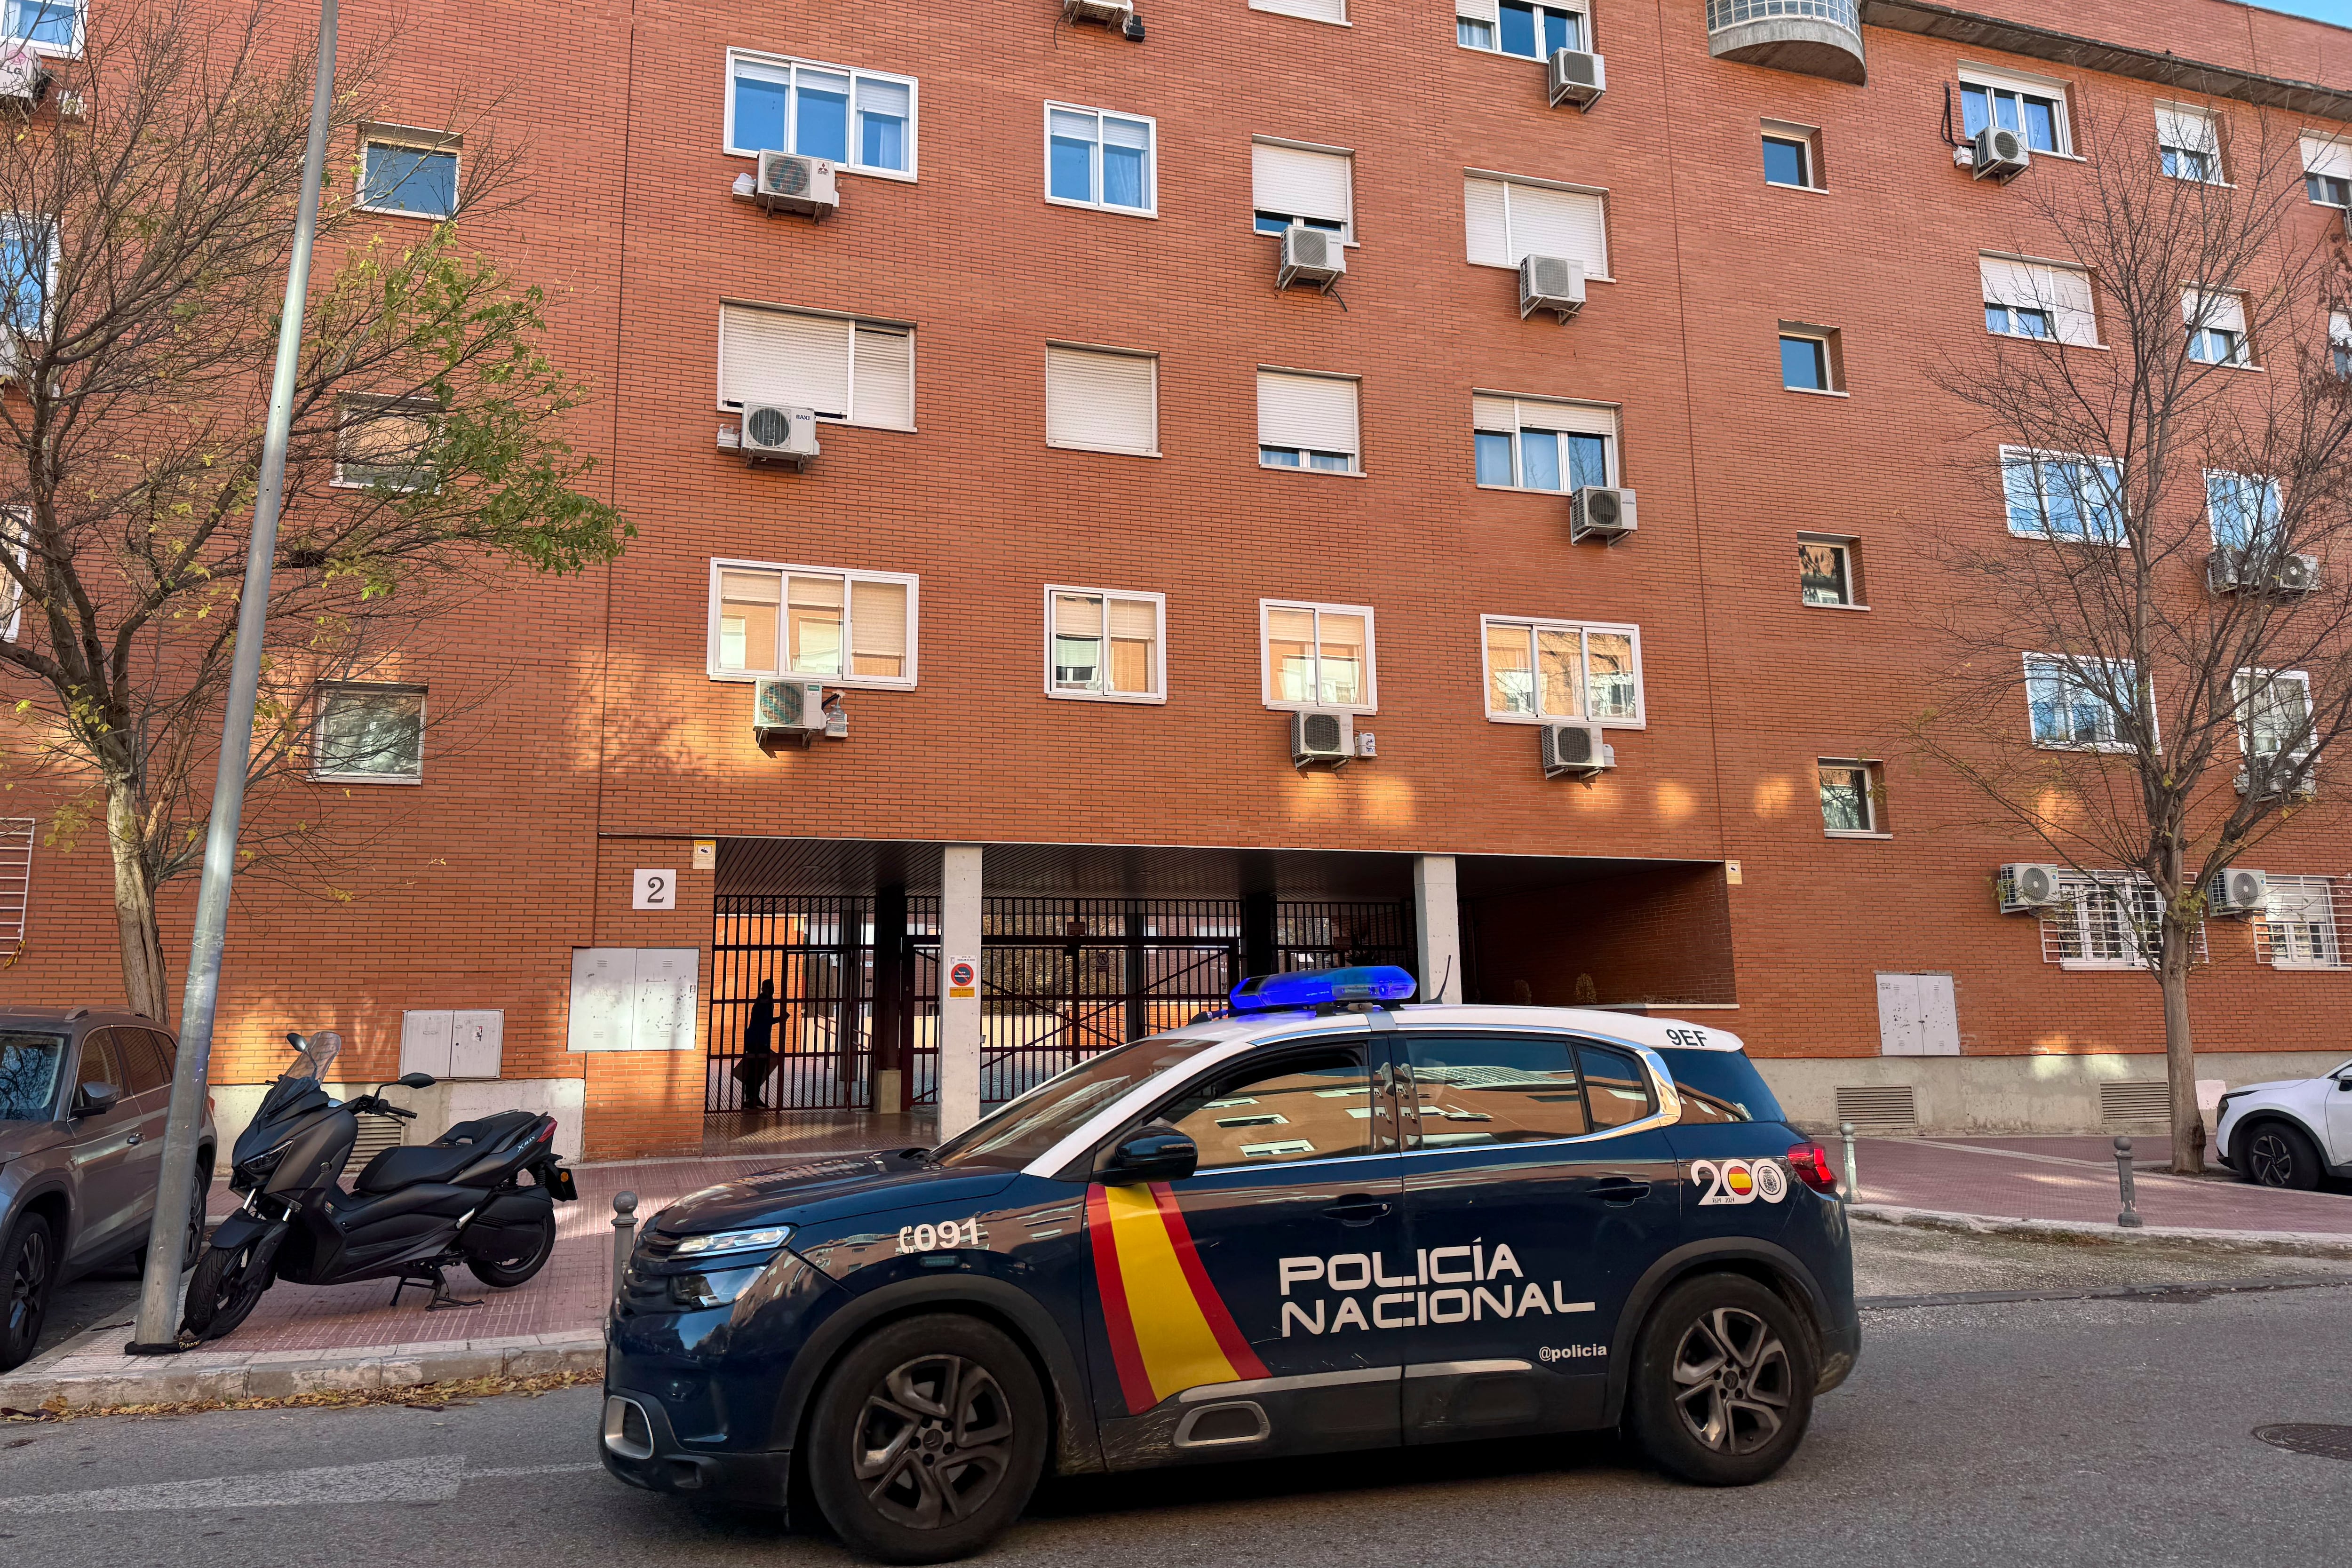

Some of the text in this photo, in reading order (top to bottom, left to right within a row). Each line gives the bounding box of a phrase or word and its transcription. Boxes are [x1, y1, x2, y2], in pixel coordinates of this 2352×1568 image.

[7, 66, 22, 75] LG
[647, 877, 664, 903] 2
[1666, 1029, 1707, 1046] 9EF
[1691, 1159, 1787, 1205] 200
[914, 1218, 978, 1251] 091
[1279, 1236, 1524, 1296] POLICÍA
[1281, 1280, 1596, 1337] NACIONAL
[1539, 1344, 1607, 1362] @policia
